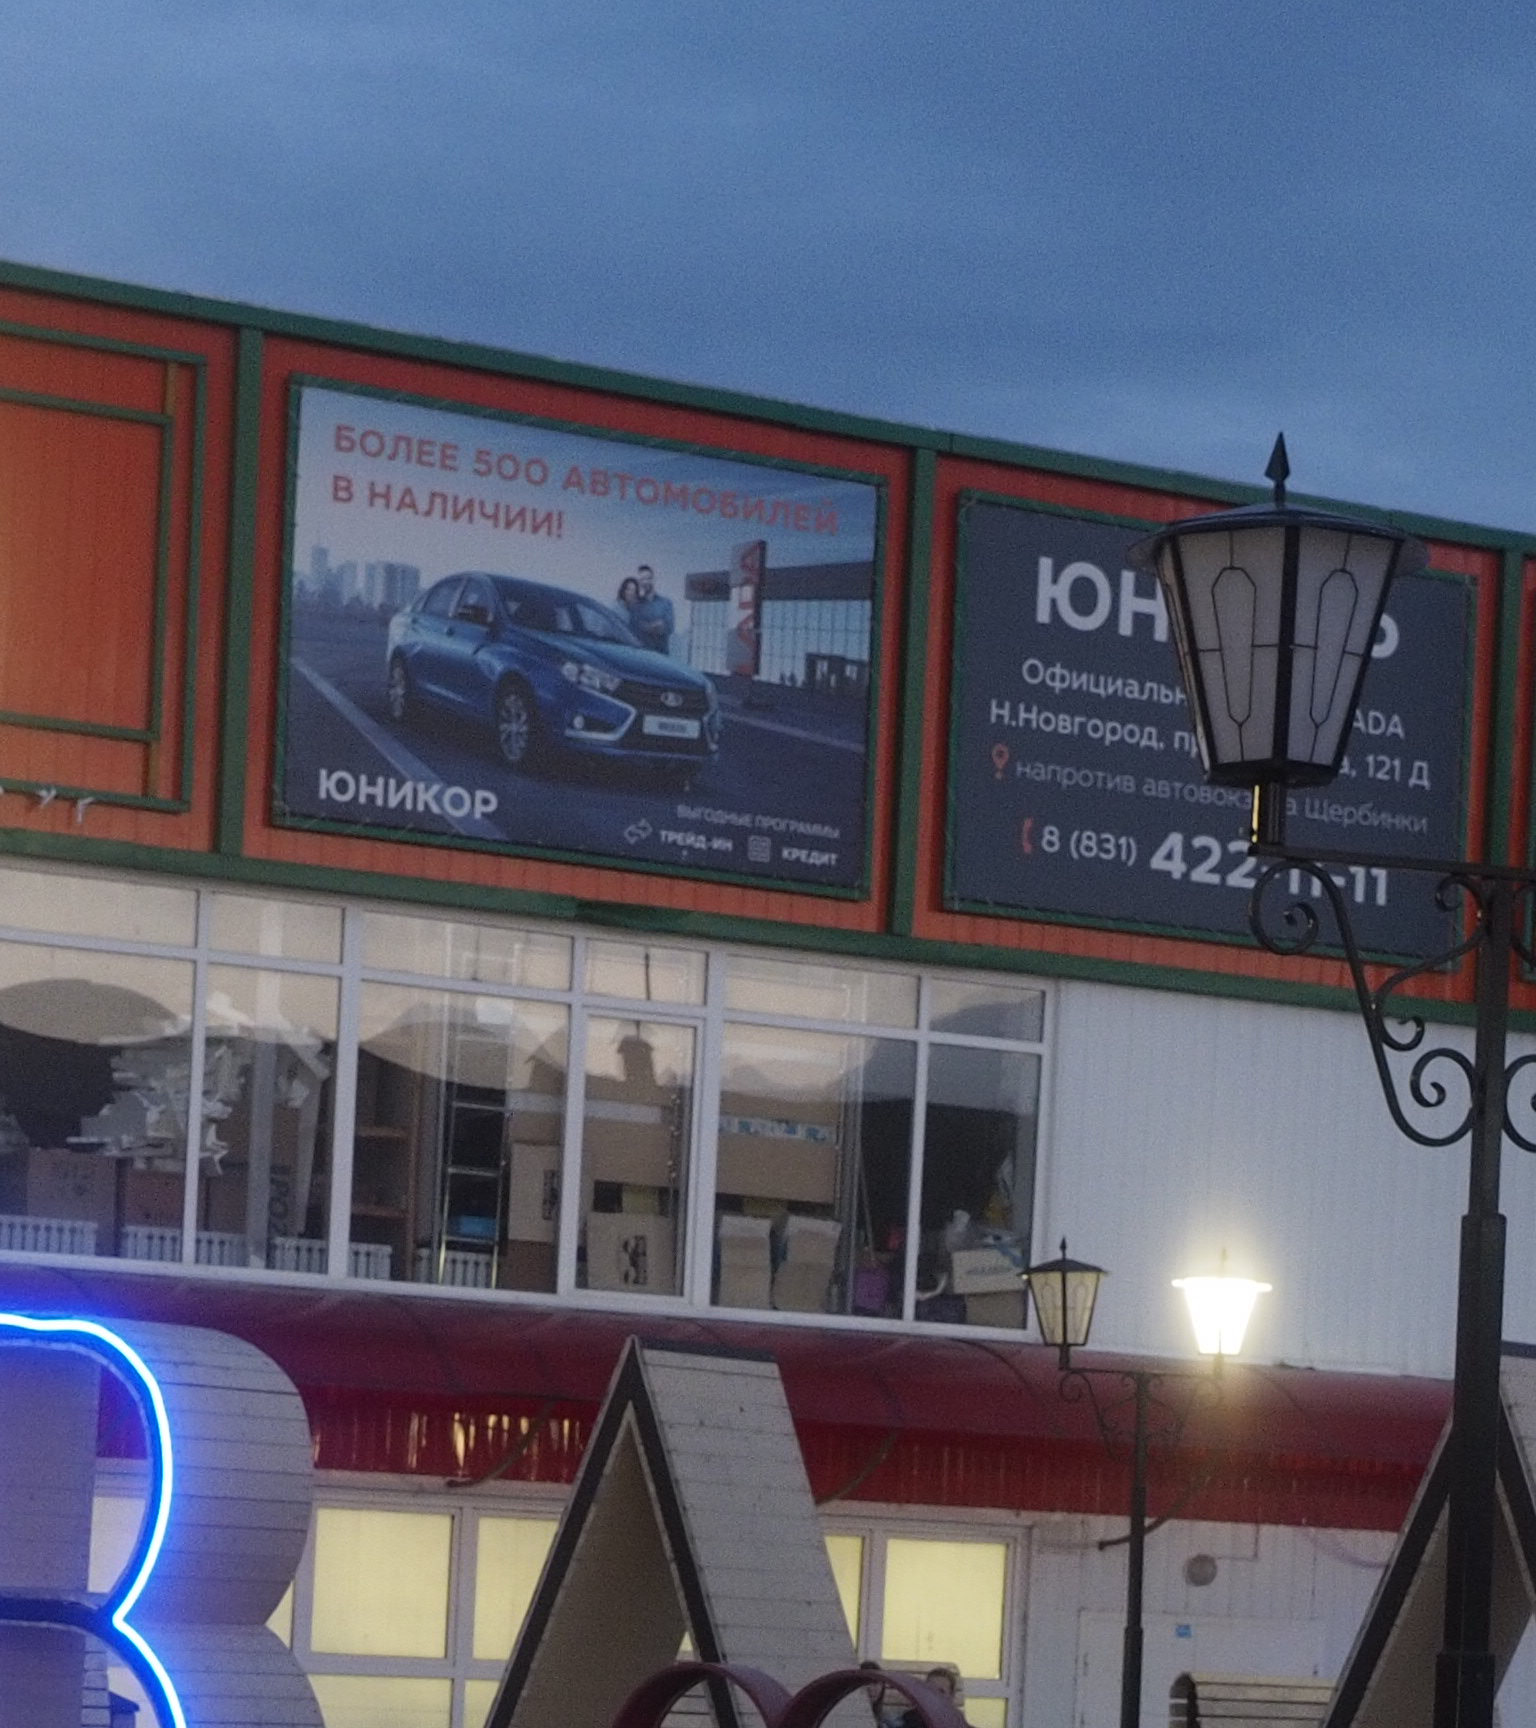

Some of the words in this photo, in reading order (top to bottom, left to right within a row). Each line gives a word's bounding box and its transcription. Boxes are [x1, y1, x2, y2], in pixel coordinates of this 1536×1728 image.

[331, 474, 355, 503] В
[367, 480, 565, 540] НАЛИЧИИ!
[332, 424, 460, 473] БОЛЕЕ
[473, 448, 550, 487] 500
[562, 465, 839, 536] АВТОМОБИЛЕЙ
[989, 699, 1166, 752] Н.Новгород,
[1365, 754, 1402, 782] 121
[1407, 760, 1432, 791] Д
[1353, 708, 1406, 740] ADA
[317, 767, 499, 821] ЮНИКОР
[1015, 761, 1137, 796] напротив
[1141, 778, 1298, 816] автовокза
[1304, 802, 1429, 836] Щербинки
[780, 846, 839, 867] КРЕДИТ
[1040, 825, 1062, 853] 8
[1069, 828, 1138, 867] (831)
